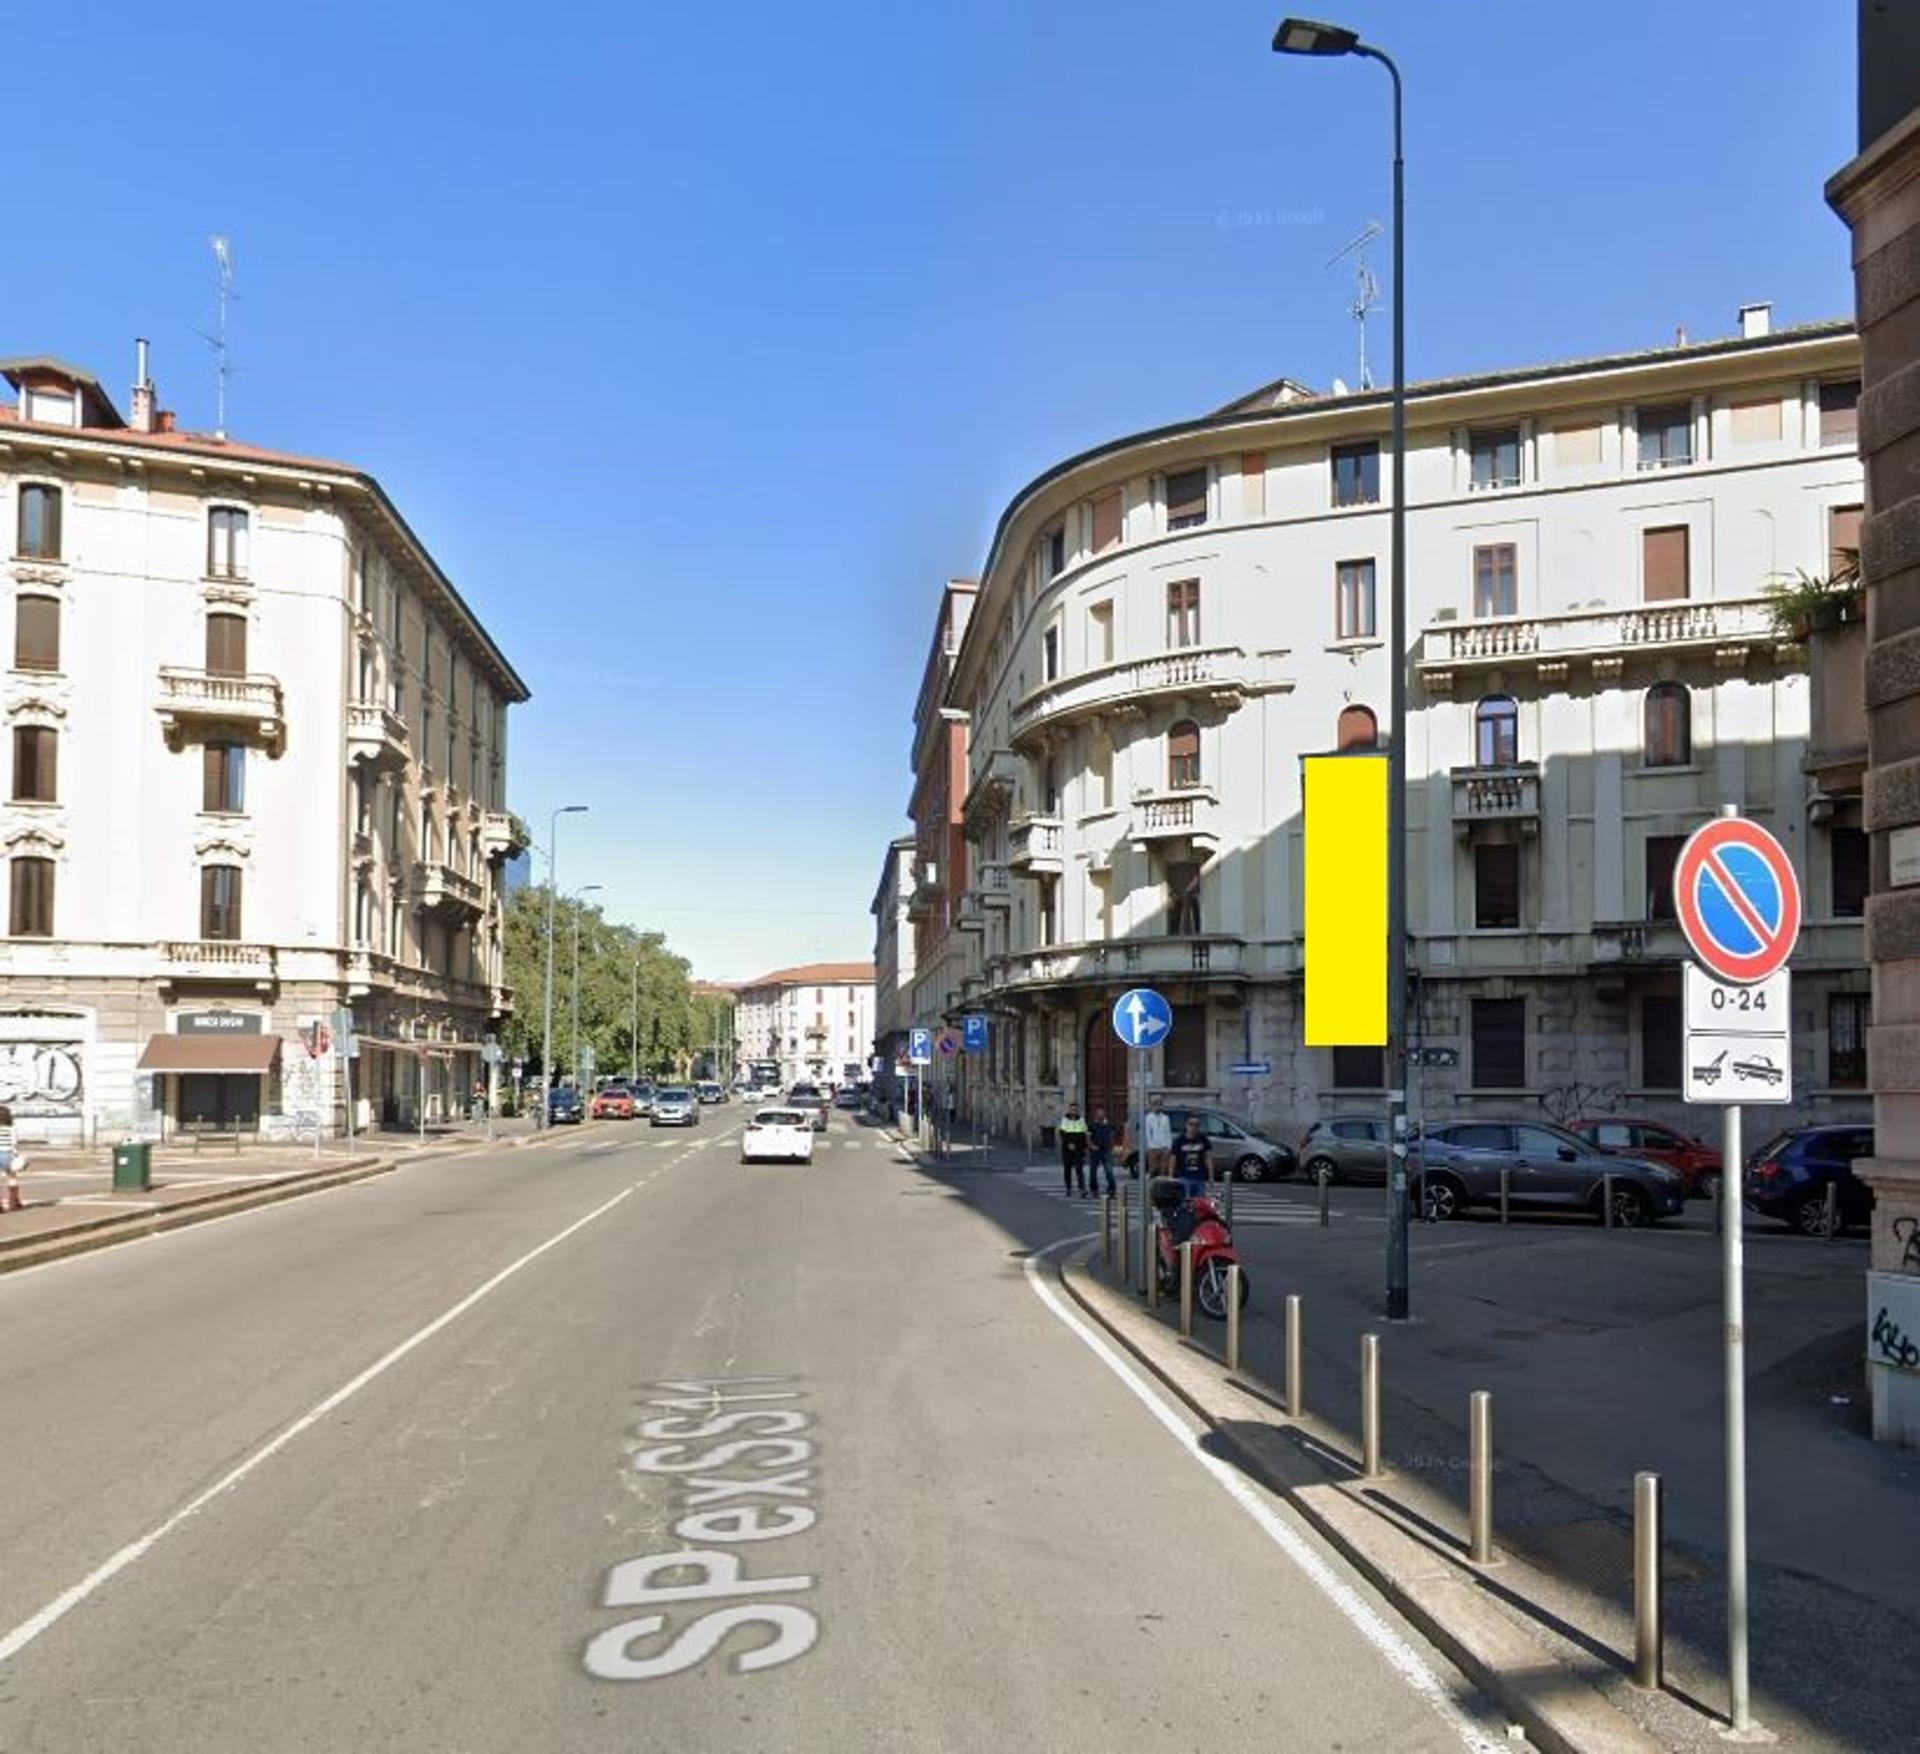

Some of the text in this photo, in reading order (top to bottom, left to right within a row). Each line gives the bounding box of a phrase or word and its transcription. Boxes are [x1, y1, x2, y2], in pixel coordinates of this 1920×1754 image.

[1711, 988, 1767, 1010] 0-24
[967, 1018, 981, 1036] P
[913, 1032, 926, 1049] P
